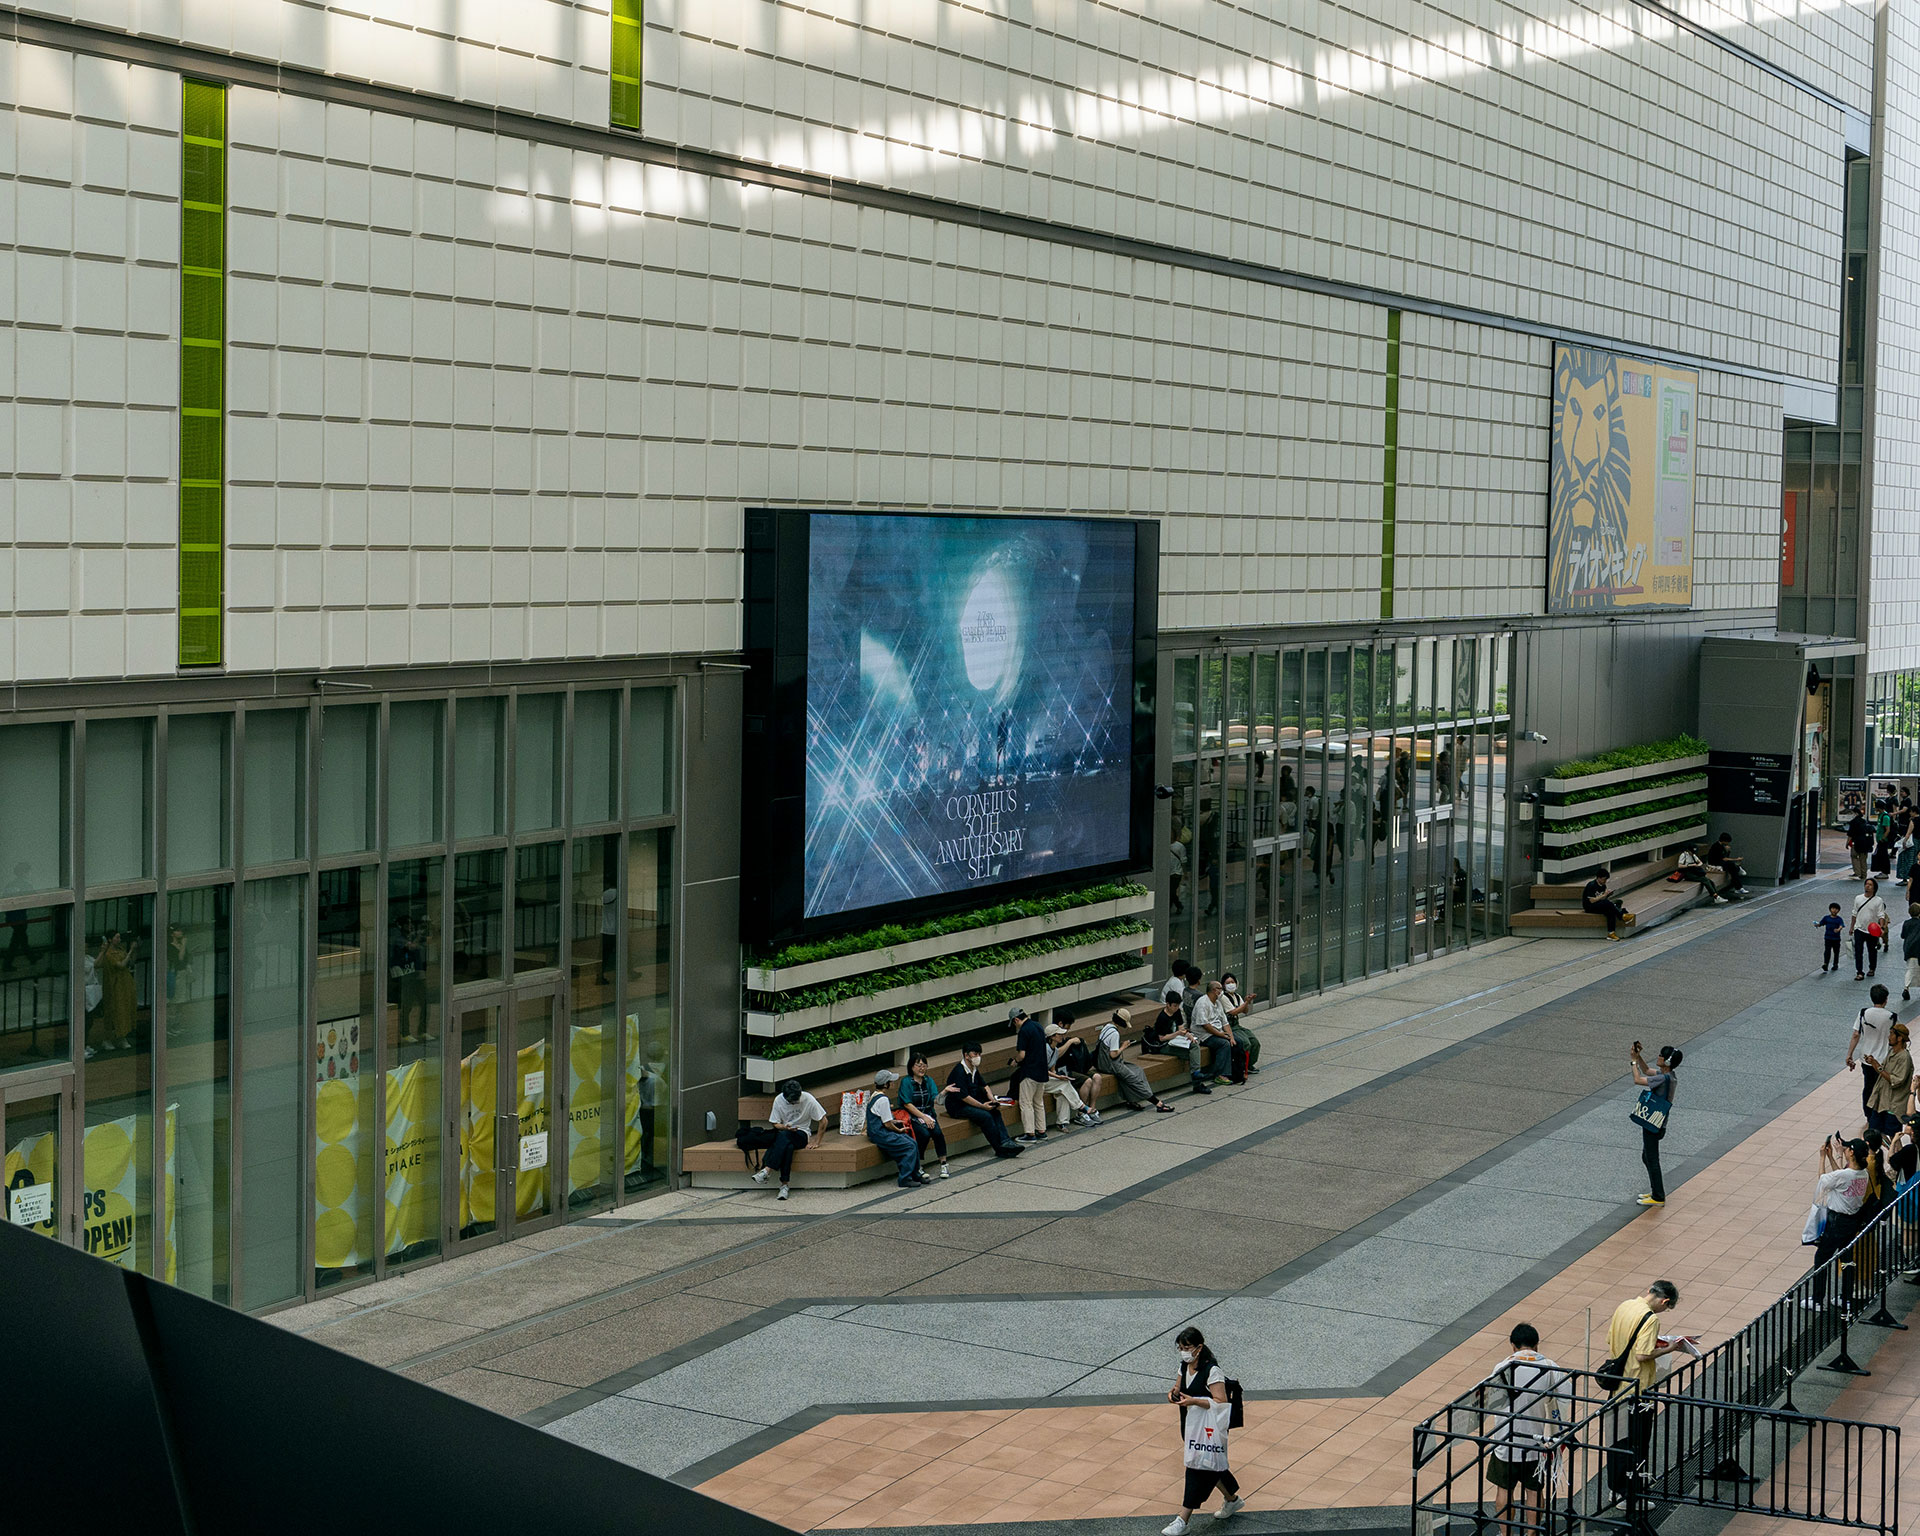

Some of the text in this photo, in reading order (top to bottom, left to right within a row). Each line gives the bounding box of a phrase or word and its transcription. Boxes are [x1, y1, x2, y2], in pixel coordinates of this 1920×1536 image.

[1568, 540, 1648, 595] ライオンキング
[946, 788, 1017, 820] CORNELIUS
[965, 811, 1000, 837] 30TH
[934, 827, 1027, 866] ANNIVERSARY
[385, 1153, 421, 1176] RIAKE
